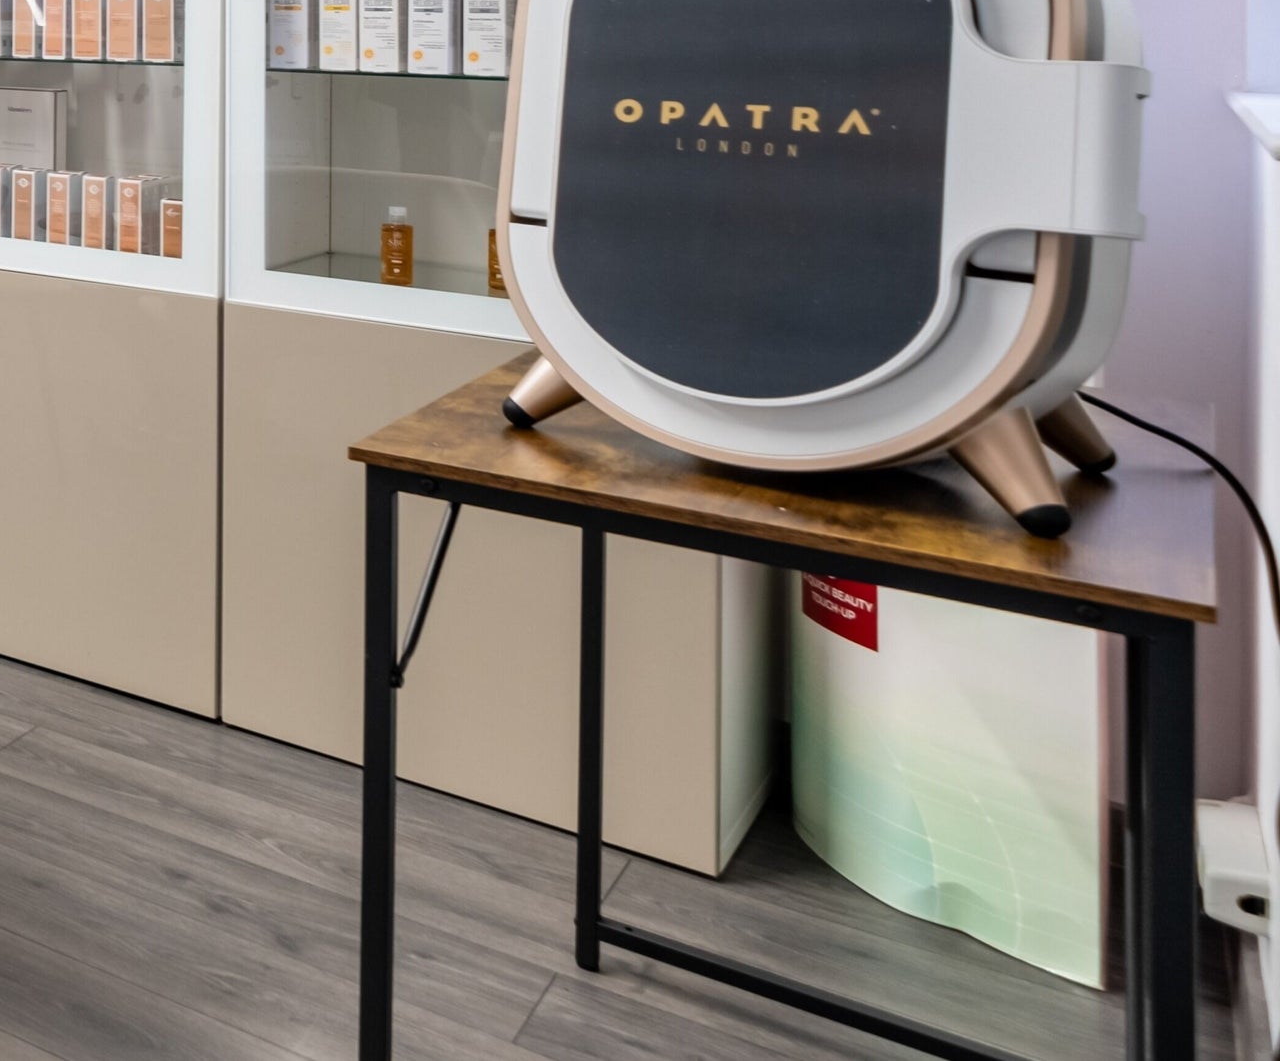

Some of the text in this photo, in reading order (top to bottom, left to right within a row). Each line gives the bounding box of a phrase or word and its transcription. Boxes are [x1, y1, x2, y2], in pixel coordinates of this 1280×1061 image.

[613, 98, 873, 135] OPATRA
[676, 137, 799, 157] LONDON
[831, 587, 874, 613] BEAUTY
